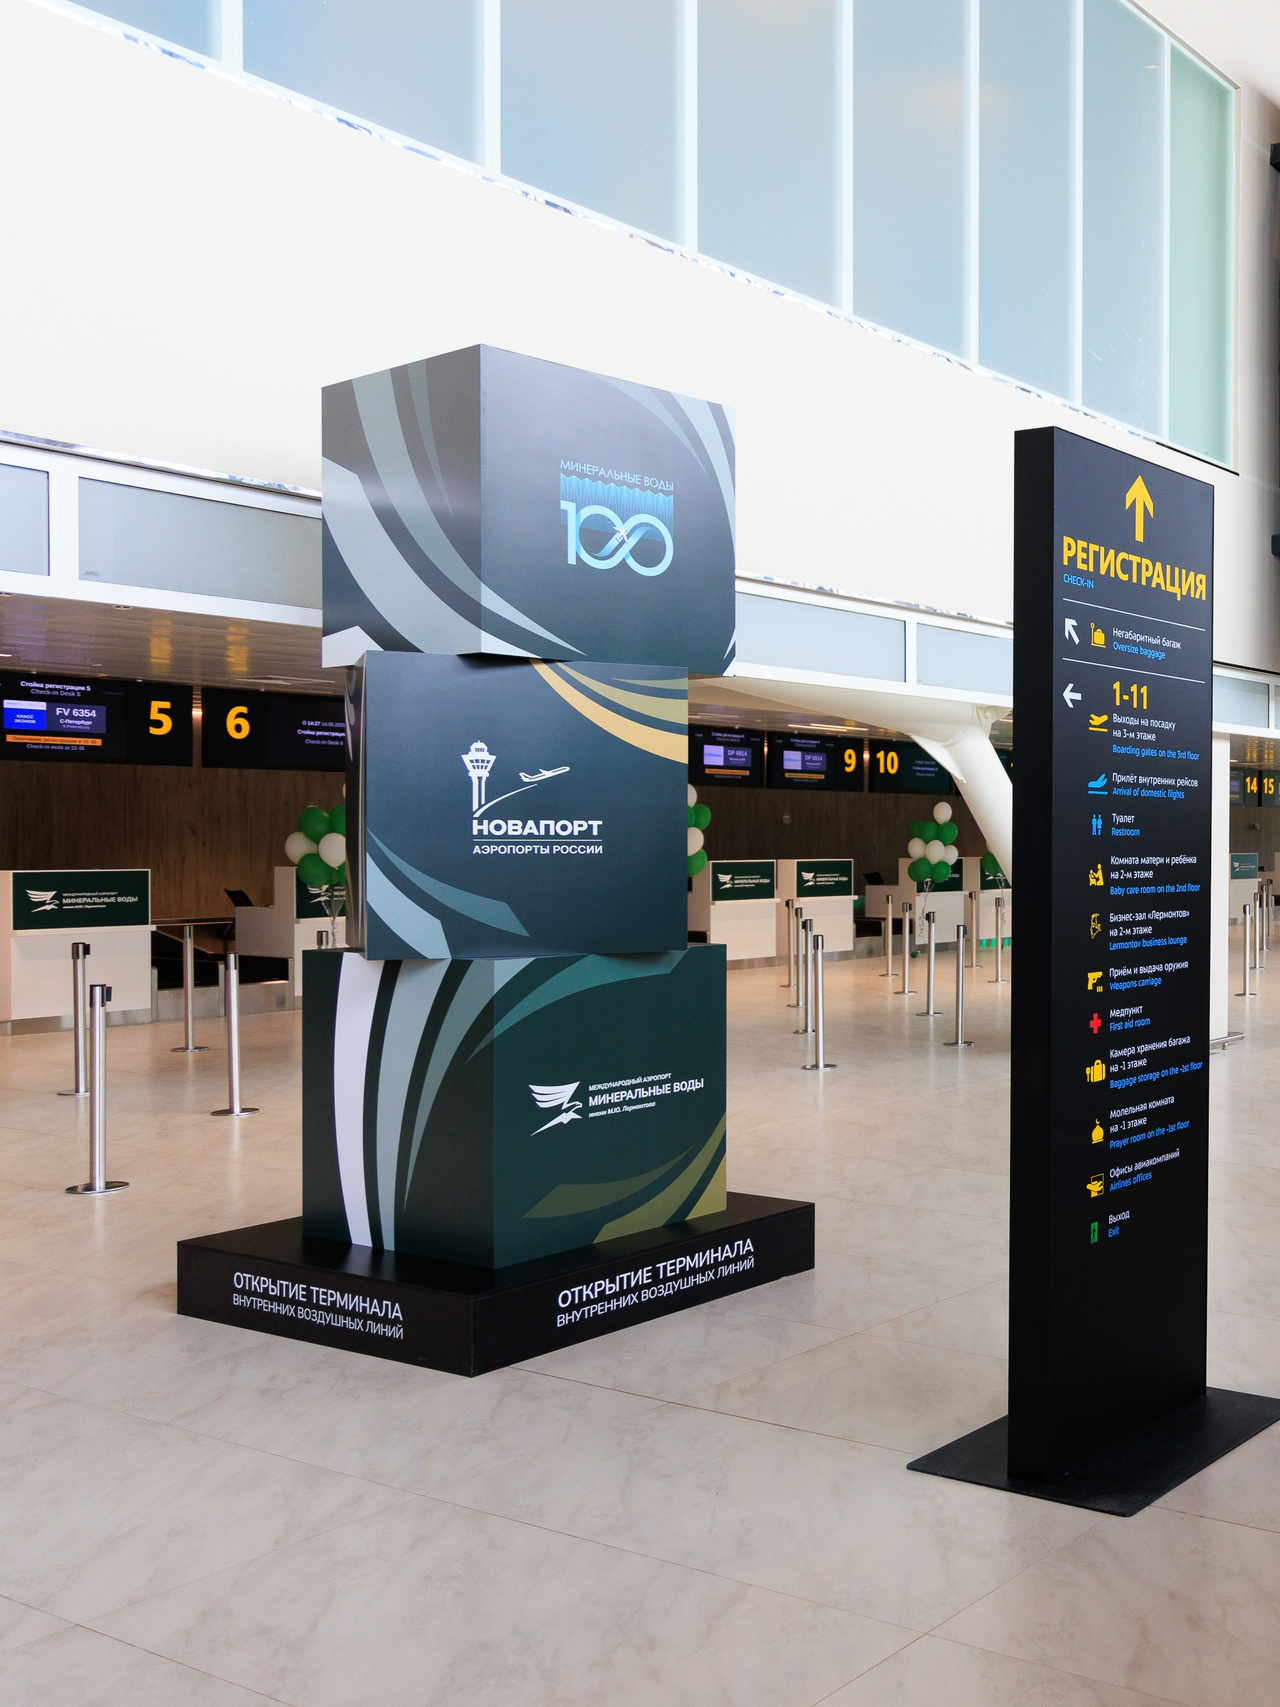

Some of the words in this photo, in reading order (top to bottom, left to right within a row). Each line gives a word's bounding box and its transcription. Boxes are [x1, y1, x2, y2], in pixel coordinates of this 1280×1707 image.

[560, 460, 642, 485] МИНЕРАЛЬНЫЕ
[644, 476, 674, 491] ВОДЫ
[560, 499, 674, 577] 100
[1062, 535, 1206, 601] РЕГИСТРАЦИЯ
[1062, 573, 1094, 589] CHECK-IN
[1112, 627, 1161, 646] Негабаритный
[1161, 637, 1182, 650] багаж
[1112, 641, 1139, 654] Oversize
[1139, 646, 1166, 660] baggage
[20, 681, 44, 689] Стойка
[45, 683, 86, 691] регистрации
[30, 688, 59, 696] Check-in
[1112, 681, 1148, 710] 1-11
[56, 707, 70, 716] FV
[72, 708, 97, 718] 6354
[149, 700, 173, 736] 5
[226, 705, 250, 739] 6
[1112, 713, 1140, 726] Выходы
[1140, 717, 1149, 726] на
[1149, 718, 1176, 732] посадку
[1112, 729, 1122, 738] на
[1122, 729, 1135, 740] 3-м
[1136, 731, 1156, 742] этаже
[843, 748, 857, 772] 9
[1112, 744, 1140, 757] Boarding
[1141, 748, 1157, 758] gates
[1158, 749, 1166, 758] on
[1166, 749, 1176, 759] the
[1177, 750, 1187, 760] 3rd
[1186, 751, 1200, 760] floor
[876, 750, 899, 775] 10
[1112, 772, 1138, 784] Прилёт
[1138, 776, 1176, 787] внутренних
[1176, 777, 1199, 788] рейсов
[1245, 776, 1258, 793] 14
[1263, 777, 1275, 794] 15
[1112, 786, 1132, 796] Arrival
[1132, 787, 1140, 797] of
[1140, 787, 1167, 798] domestic
[1167, 788, 1185, 800] flights
[472, 819, 603, 836] НОВАПОРТ
[1111, 813, 1135, 825] Туалет
[1111, 827, 1140, 837] Restroom
[473, 845, 550, 855] АЭРОПОРТЫ
[553, 845, 603, 855] РОССИИ
[1110, 855, 1140, 865] Комната
[1140, 857, 1165, 867] матери
[1170, 854, 1197, 866] ребёнка
[1110, 871, 1119, 880] на
[1119, 869, 1133, 879] 2-м
[1133, 870, 1154, 879] этаже
[1110, 886, 1126, 897] Baby
[1126, 887, 1139, 895] care
[1140, 886, 1156, 894] room
[1165, 884, 1176, 893] the
[1175, 883, 1187, 892] 2nd
[1187, 883, 1201, 892] floor
[62, 896, 116, 904] МИНЕРАЛЬНЫЕ
[1109, 912, 1147, 922] Бизнес-зал
[1147, 910, 1190, 921] «Лермонтов»
[1109, 928, 1119, 937] на
[1119, 926, 1132, 936] 2-м
[1132, 925, 1153, 935] этаже
[1109, 940, 1141, 951] Lermontov
[1141, 938, 1167, 948] business
[1167, 936, 1188, 946] lounge
[1109, 967, 1132, 979] Приём
[1139, 964, 1164, 975] выдача
[1164, 961, 1189, 973] оружия
[1109, 980, 1138, 991] Weapons
[1138, 976, 1162, 987] carriage
[1109, 1005, 1144, 1018] Медпункт
[1109, 1021, 1123, 1031] First
[1123, 1019, 1134, 1029] aid
[1134, 1018, 1151, 1027] room
[1109, 1046, 1136, 1058] Камера
[1136, 1040, 1168, 1055] хранения
[1168, 1035, 1191, 1047] багажа
[1109, 1064, 1119, 1073] на
[1126, 1058, 1148, 1070] этаже
[588, 1076, 643, 1091] МЕЖДУНАРОДНЫЙ
[643, 1073, 672, 1084] АЭРОПОРТ
[1109, 1075, 1137, 1089] Baggage
[1137, 1070, 1160, 1083] storage
[1160, 1069, 1169, 1078] on
[1169, 1066, 1179, 1076] the
[1189, 1061, 1203, 1071] floor
[588, 1083, 672, 1107] МИНЕРАЛЬНЫЕ
[673, 1078, 704, 1093] ВОДЫ
[1109, 1102, 1148, 1120] Молельная
[1148, 1095, 1175, 1110] комната
[1109, 1124, 1119, 1133] на
[1119, 1120, 1126, 1130] -1
[1126, 1116, 1148, 1129] этаже
[1109, 1138, 1130, 1149] Prayer
[1130, 1134, 1147, 1144] room
[1146, 1131, 1155, 1139] on
[1155, 1127, 1165, 1137] the
[1176, 1120, 1190, 1130] floor
[1109, 1164, 1133, 1178] Офисы
[1133, 1148, 1181, 1170] авиакомпаний
[1109, 1179, 1132, 1191] Airlines
[1132, 1171, 1153, 1184] offices
[1108, 1210, 1130, 1224] Выход
[1108, 1226, 1120, 1238] Exit
[557, 1266, 652, 1308] ОТКРЫТИЕ
[656, 1238, 754, 1279] ТЕРМИНАЛА
[234, 1272, 307, 1302] ОТКРЫТИЕ
[310, 1286, 403, 1321] ТЕРМИНАЛА
[556, 1292, 639, 1328] ВНУТРЕННИХ
[641, 1270, 715, 1302] ВОЗДУШНЫХ
[716, 1255, 755, 1279] ЛИНИЙ
[233, 1293, 296, 1318] ВНУТРЕННИХ
[297, 1306, 364, 1332] ВОЗДУШНЫХ
[366, 1320, 403, 1340] ЛИНИЙ
